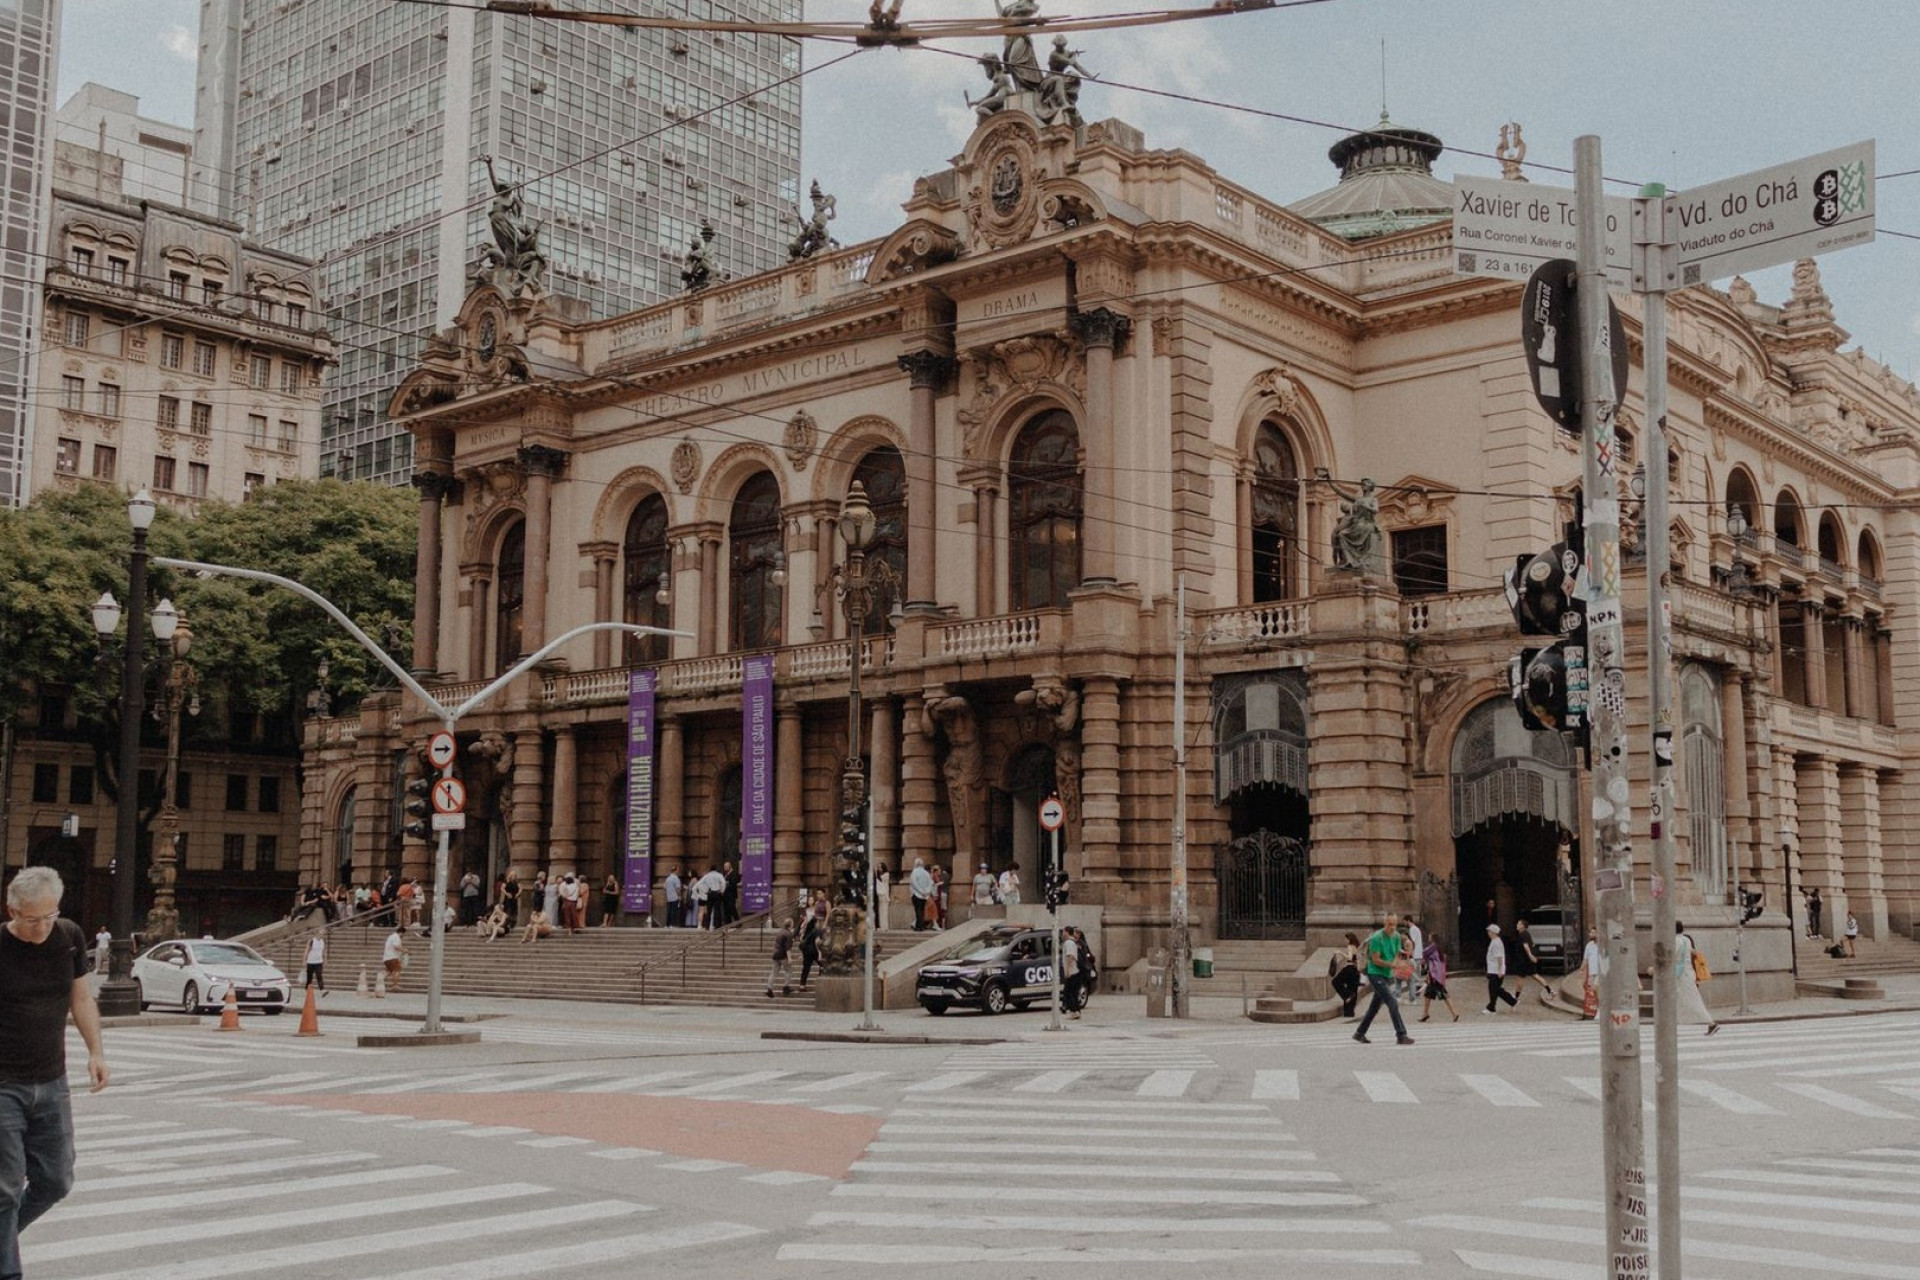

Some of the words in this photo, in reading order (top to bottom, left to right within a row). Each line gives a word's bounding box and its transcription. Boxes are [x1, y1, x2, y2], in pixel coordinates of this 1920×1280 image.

[1460, 189, 1521, 219] Xavier
[1528, 199, 1550, 223] de
[1557, 202, 1617, 232] Too
[1679, 201, 1713, 228] Vd.
[1721, 193, 1747, 217] do
[1755, 177, 1799, 208] Chá
[1460, 226, 1481, 239] Rua
[1484, 229, 1527, 245] Coronel
[1530, 235, 1562, 249] Xavier
[1680, 232, 1726, 252] Viaduto
[1729, 227, 1746, 240] do
[1749, 218, 1775, 236] Chá
[1485, 259, 1500, 271] 23
[1503, 262, 1511, 272] a
[1515, 262, 1533, 274] 161
[983, 291, 1038, 317] DRAMA
[632, 383, 724, 419] THEATRO
[743, 348, 866, 393] MVNICIPAL
[752, 695, 764, 723] PAULO
[751, 724, 765, 742] SÃO
[752, 743, 765, 755] DE
[752, 756, 765, 788] CIDADE
[628, 755, 651, 859] ENCRUZILHADA
[752, 789, 764, 802] DA
[752, 804, 764, 825] BALÉ
